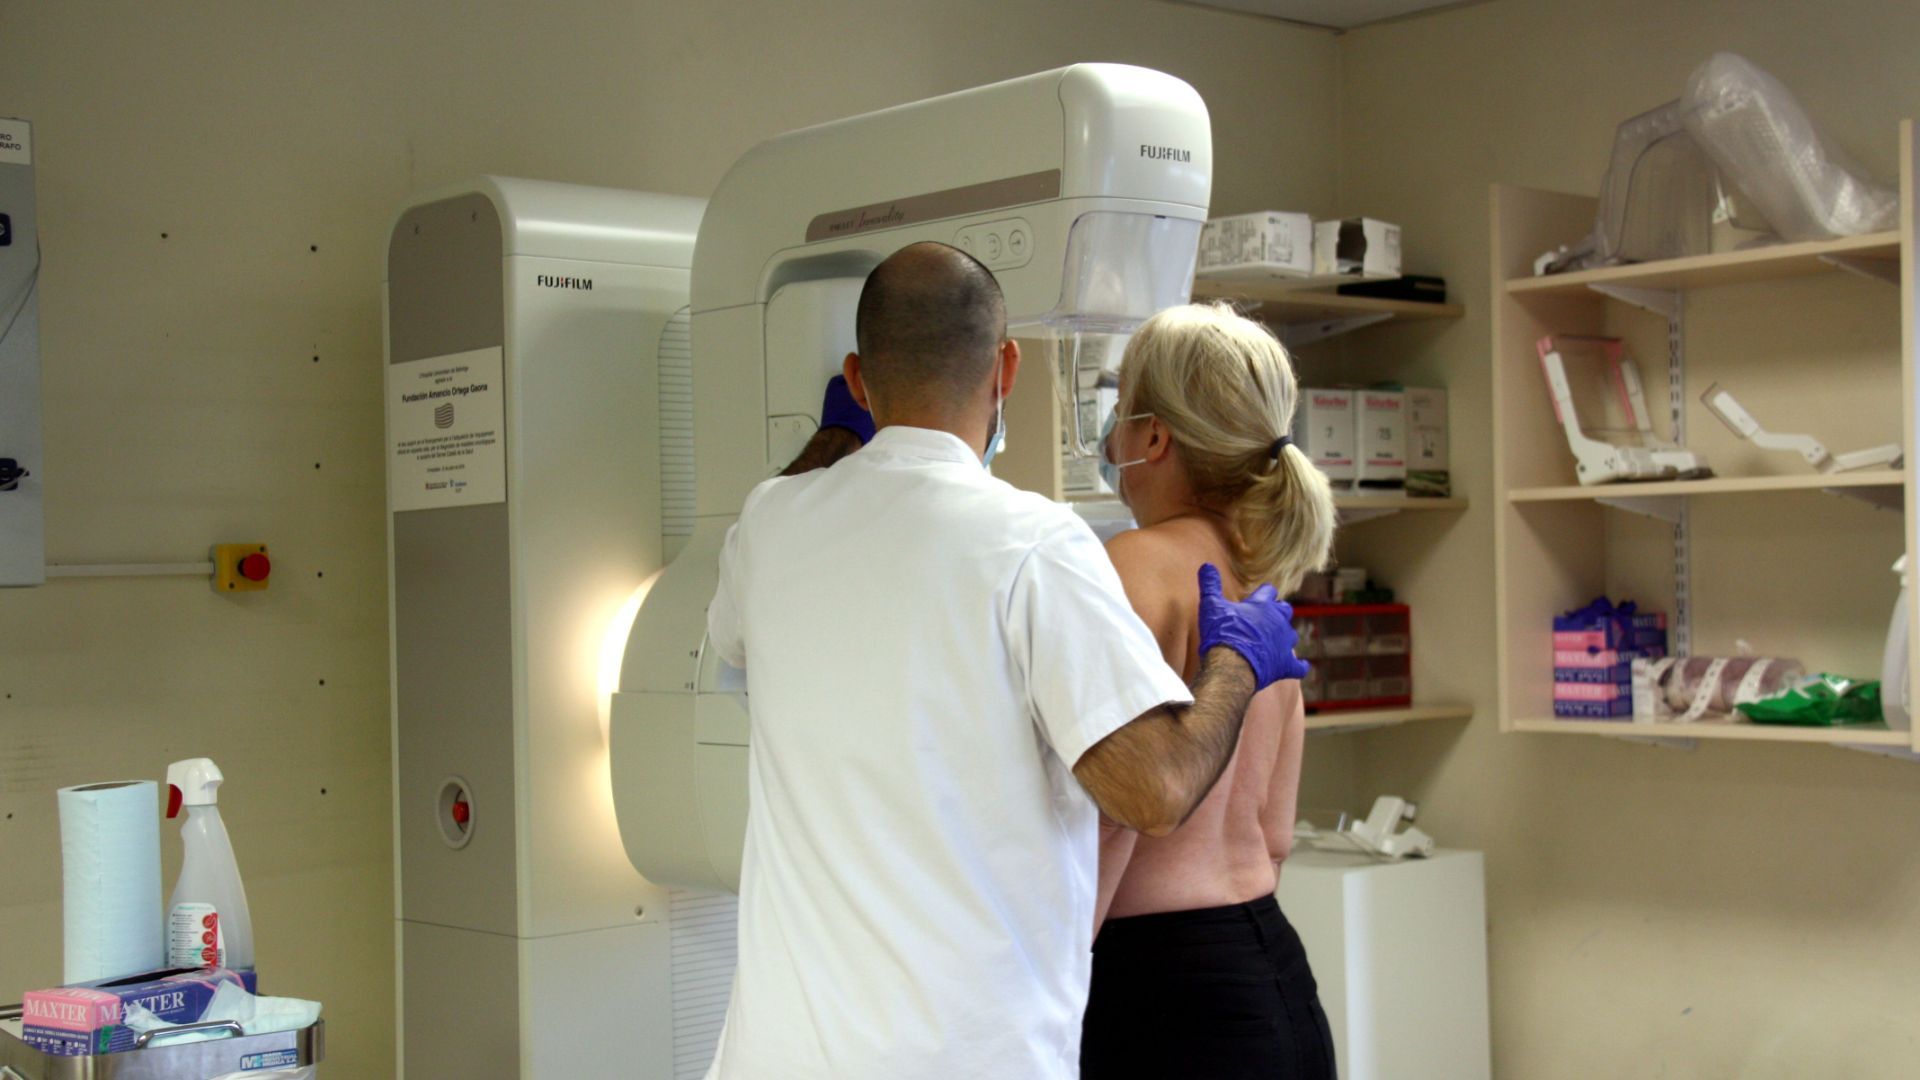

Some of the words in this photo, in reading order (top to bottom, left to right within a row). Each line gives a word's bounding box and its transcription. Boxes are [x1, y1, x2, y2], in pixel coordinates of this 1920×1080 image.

[1140, 144, 1190, 162] FUJIFILM
[537, 274, 593, 291] FUJIFILM
[428, 389, 451, 399] Amancio
[451, 386, 470, 397] Ortega
[470, 383, 488, 393] Gaona
[26, 999, 87, 1023] MAXTER
